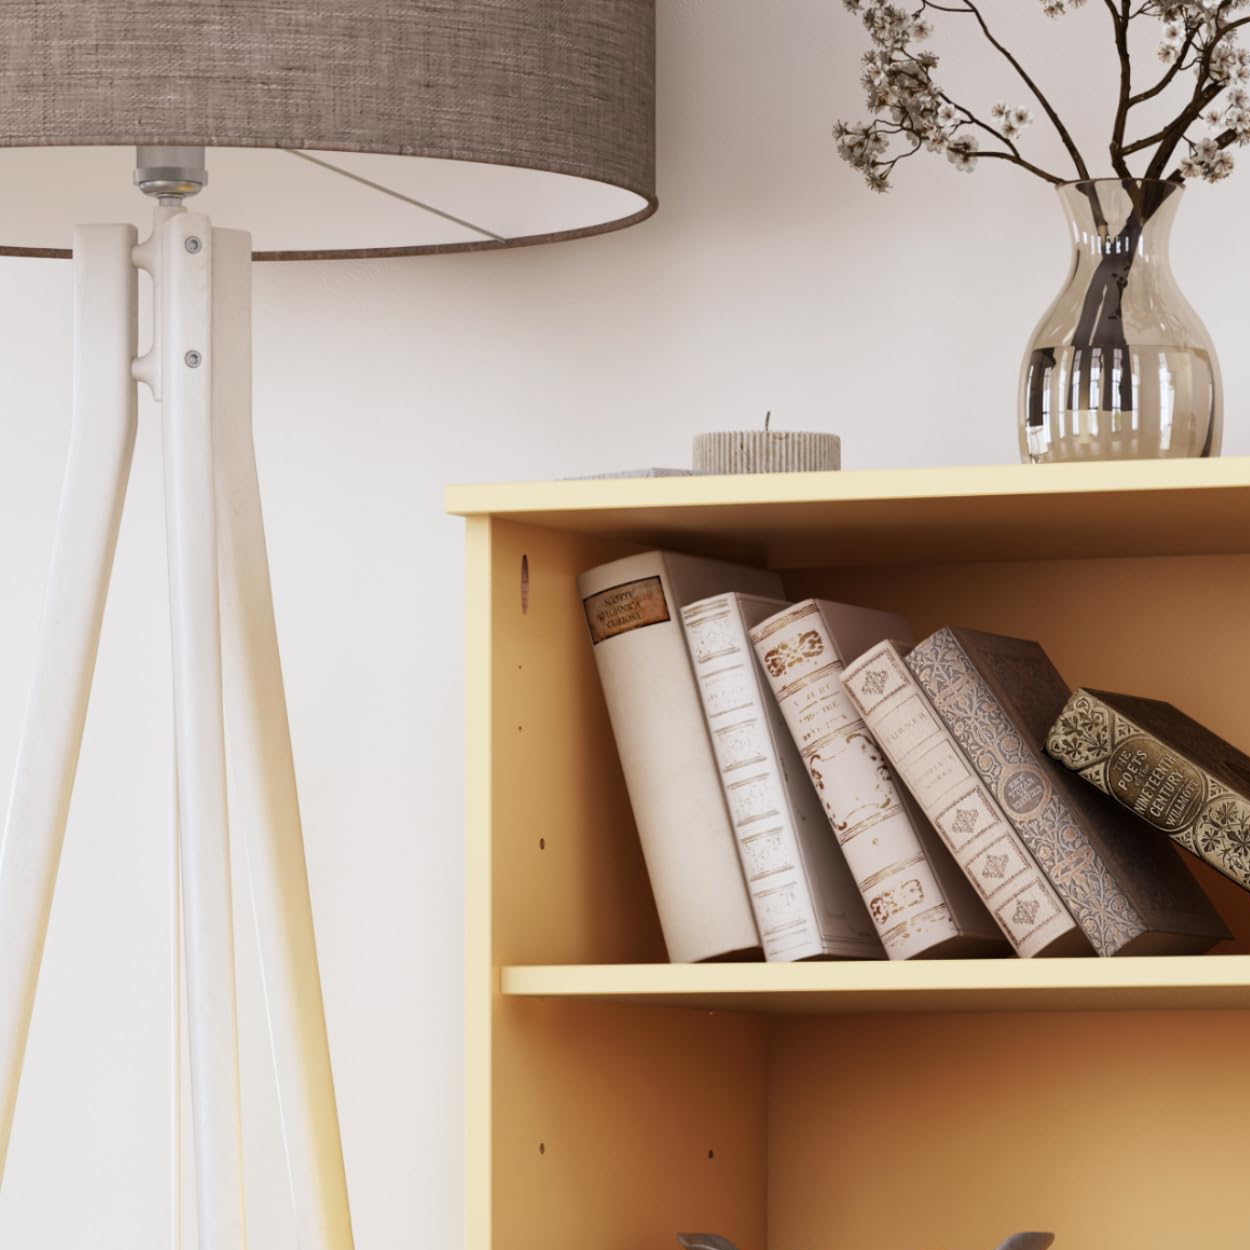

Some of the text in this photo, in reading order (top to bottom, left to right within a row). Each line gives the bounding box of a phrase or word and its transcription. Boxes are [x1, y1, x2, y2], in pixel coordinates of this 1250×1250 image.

[1113, 749, 1132, 771] THE
[1117, 749, 1148, 792] POETS
[1133, 753, 1176, 815] NINETEENTH
[1149, 768, 1184, 818] CENTURY
[1165, 780, 1199, 826] WILLMOTT
